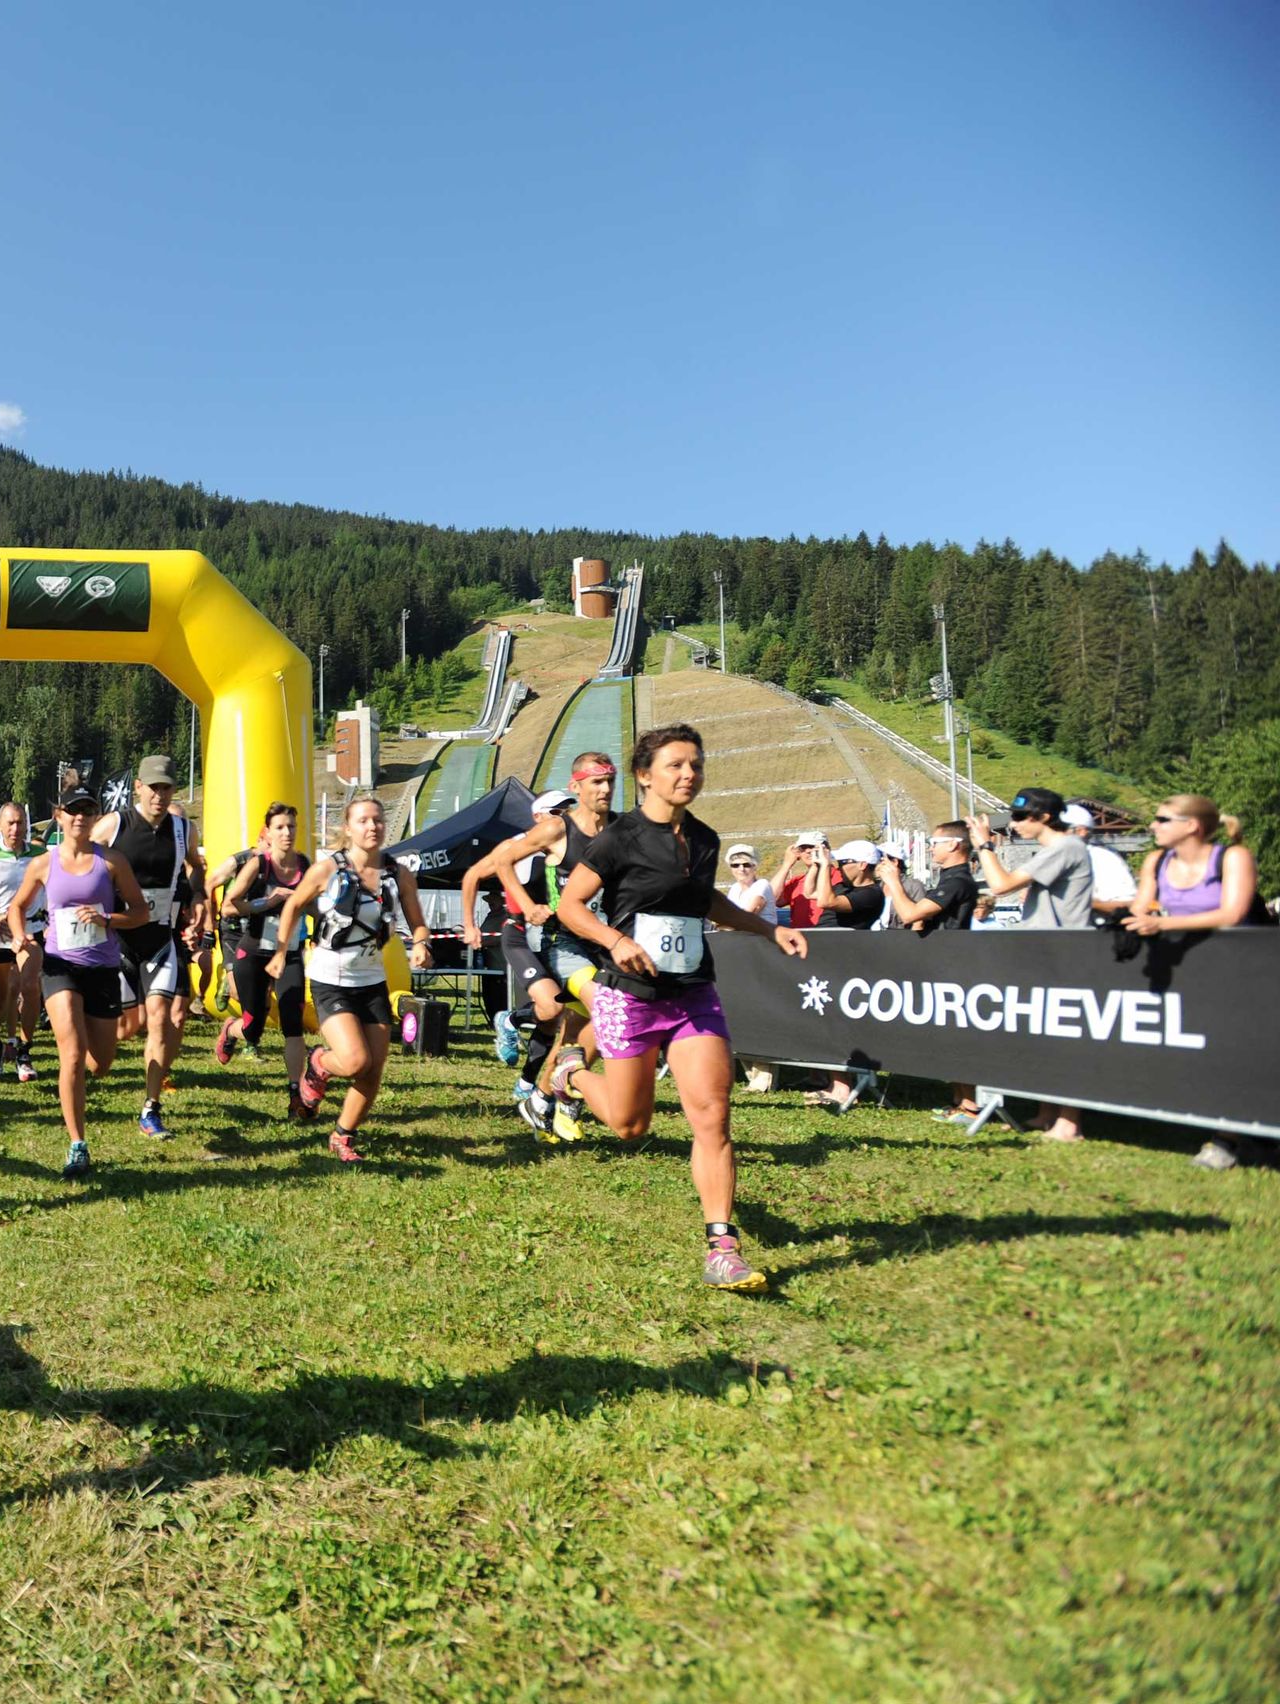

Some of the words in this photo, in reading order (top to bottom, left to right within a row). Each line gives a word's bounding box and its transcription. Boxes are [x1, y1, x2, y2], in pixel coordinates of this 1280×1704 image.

[360, 943, 377, 957] 72
[660, 935, 686, 953] 80
[839, 977, 1206, 1050] COURCHEVEL
